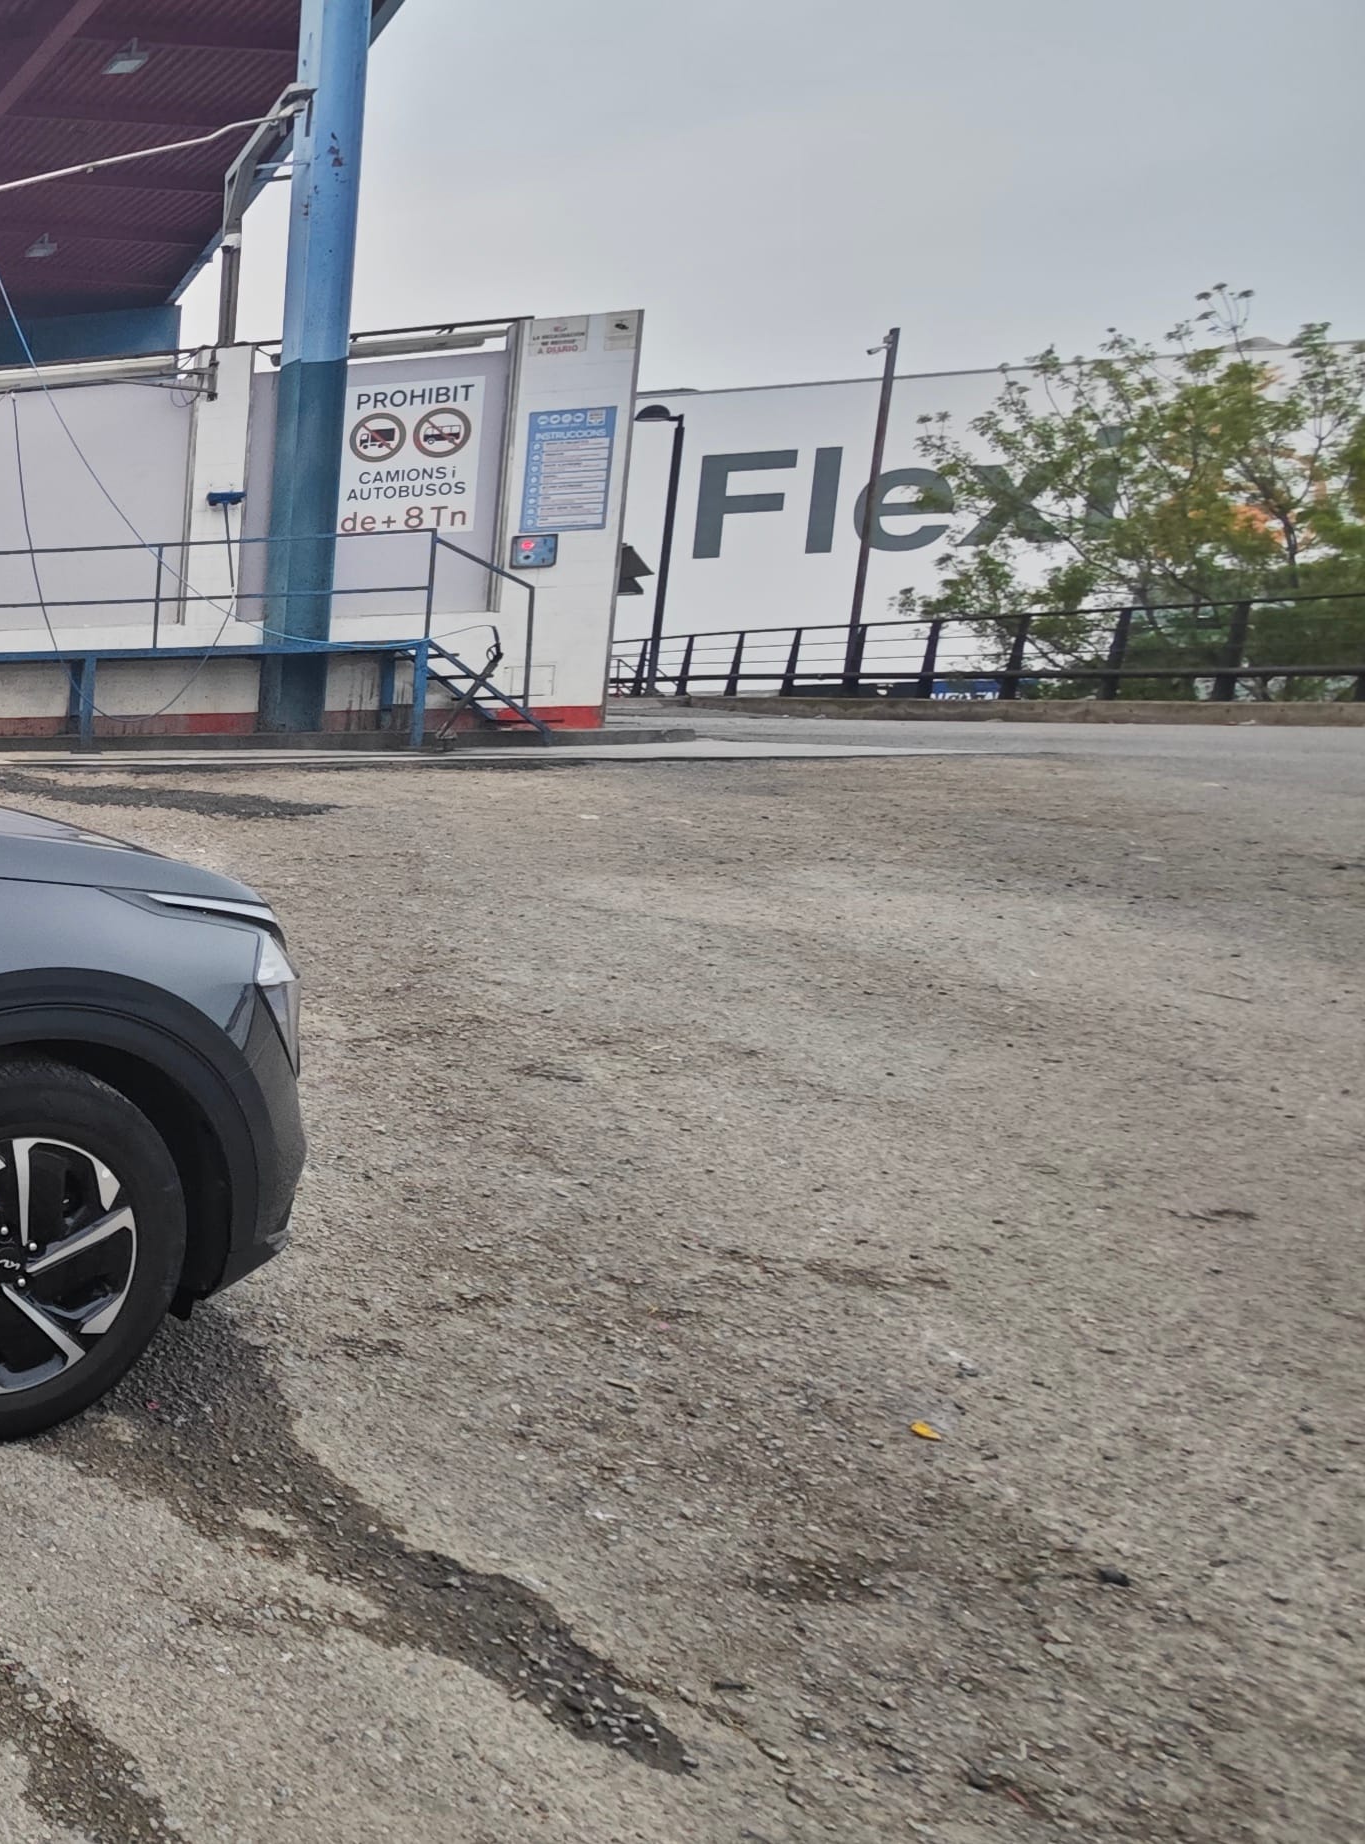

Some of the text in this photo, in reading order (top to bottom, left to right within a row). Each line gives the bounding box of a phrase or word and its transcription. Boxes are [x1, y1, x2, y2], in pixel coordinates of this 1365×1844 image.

[356, 384, 475, 410] PROHIBIT
[358, 466, 447, 485] CAMIONS
[347, 481, 466, 501] AUTOBUSOS
[340, 511, 376, 533] de
